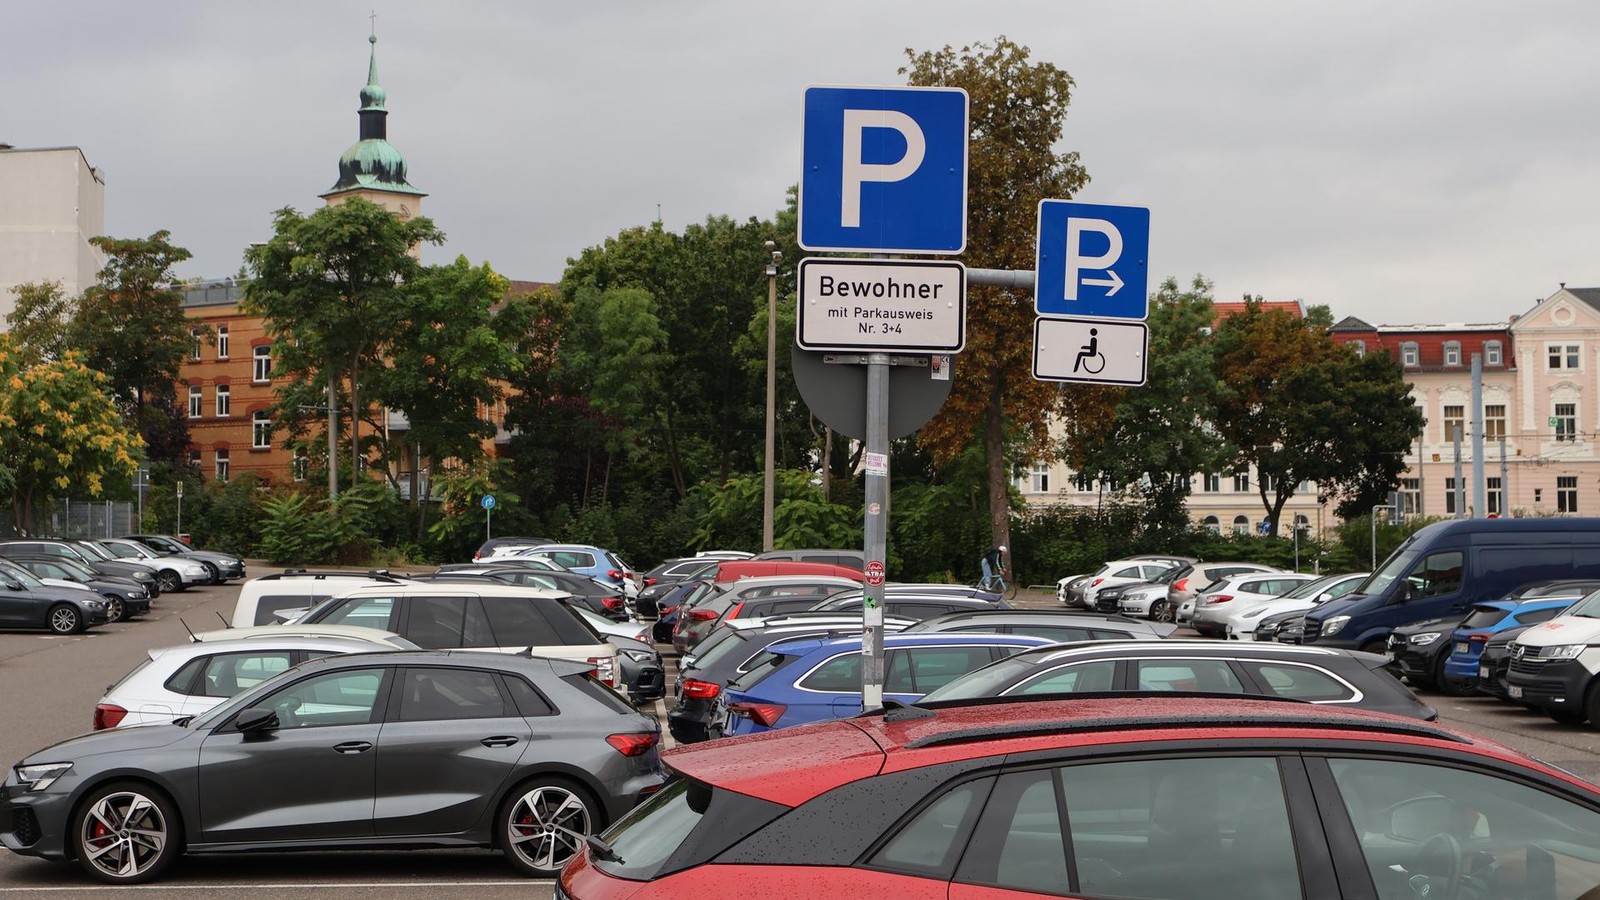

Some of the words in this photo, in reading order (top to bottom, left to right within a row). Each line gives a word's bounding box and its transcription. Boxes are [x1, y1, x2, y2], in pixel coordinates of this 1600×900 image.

[841, 109, 926, 228] P
[1064, 217, 1123, 301] P
[819, 275, 943, 299] Bewohner
[828, 307, 848, 318] mit
[854, 307, 933, 320] Parkausweis
[858, 322, 876, 334] Nr.
[881, 323, 902, 334] 3+4
